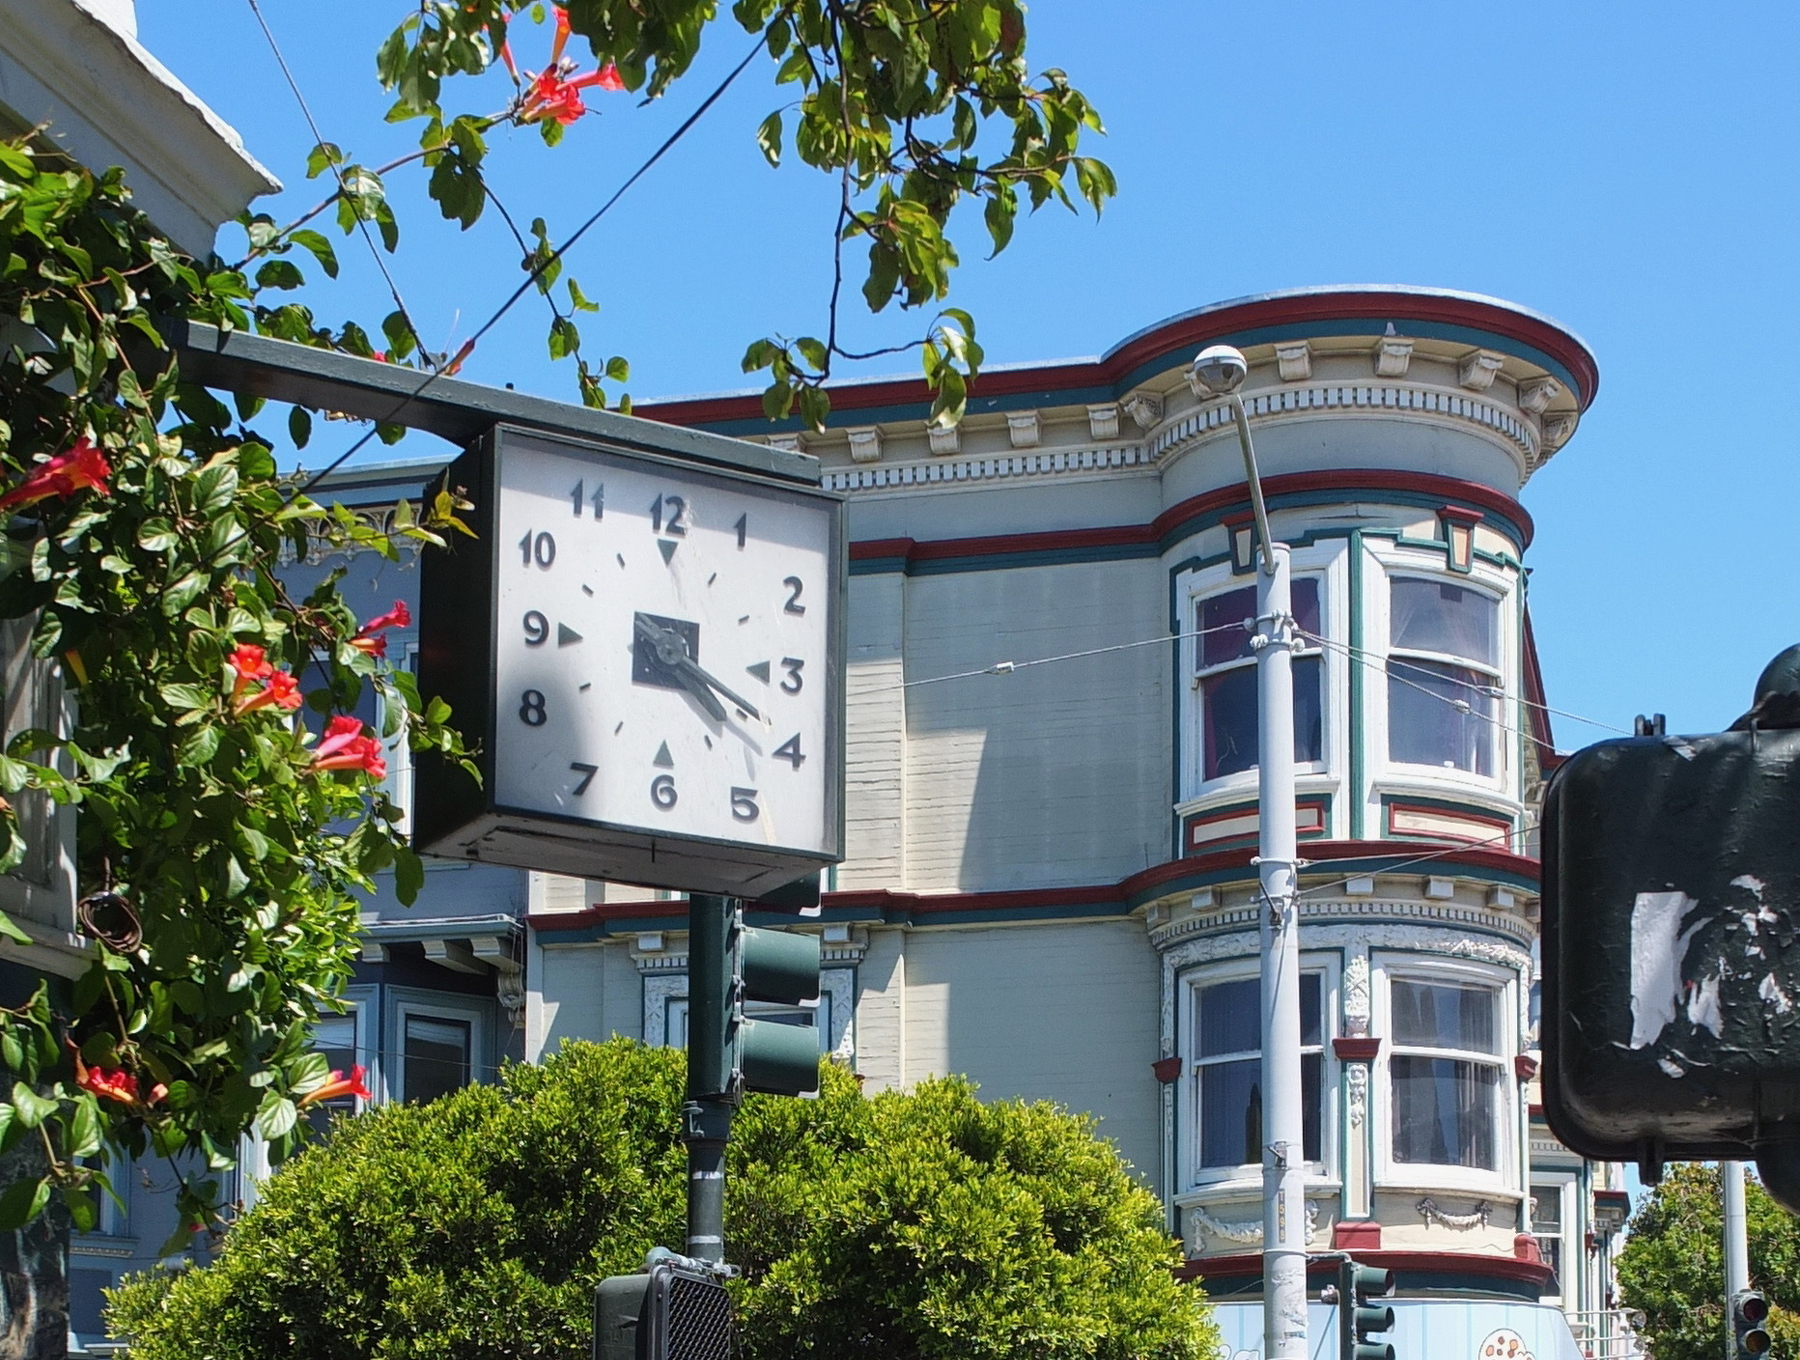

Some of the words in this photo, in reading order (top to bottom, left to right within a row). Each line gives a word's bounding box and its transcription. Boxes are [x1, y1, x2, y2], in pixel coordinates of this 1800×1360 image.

[571, 479, 605, 520] 11
[650, 493, 688, 536] 12
[519, 528, 556, 569] 10
[733, 512, 748, 549] 1
[782, 576, 807, 616] 2
[522, 610, 550, 647] 9
[780, 657, 806, 695] 3
[518, 689, 548, 727] 8
[772, 733, 807, 770] 4
[570, 762, 600, 796] 7
[650, 774, 679, 810] 6
[730, 786, 760, 822] 5
